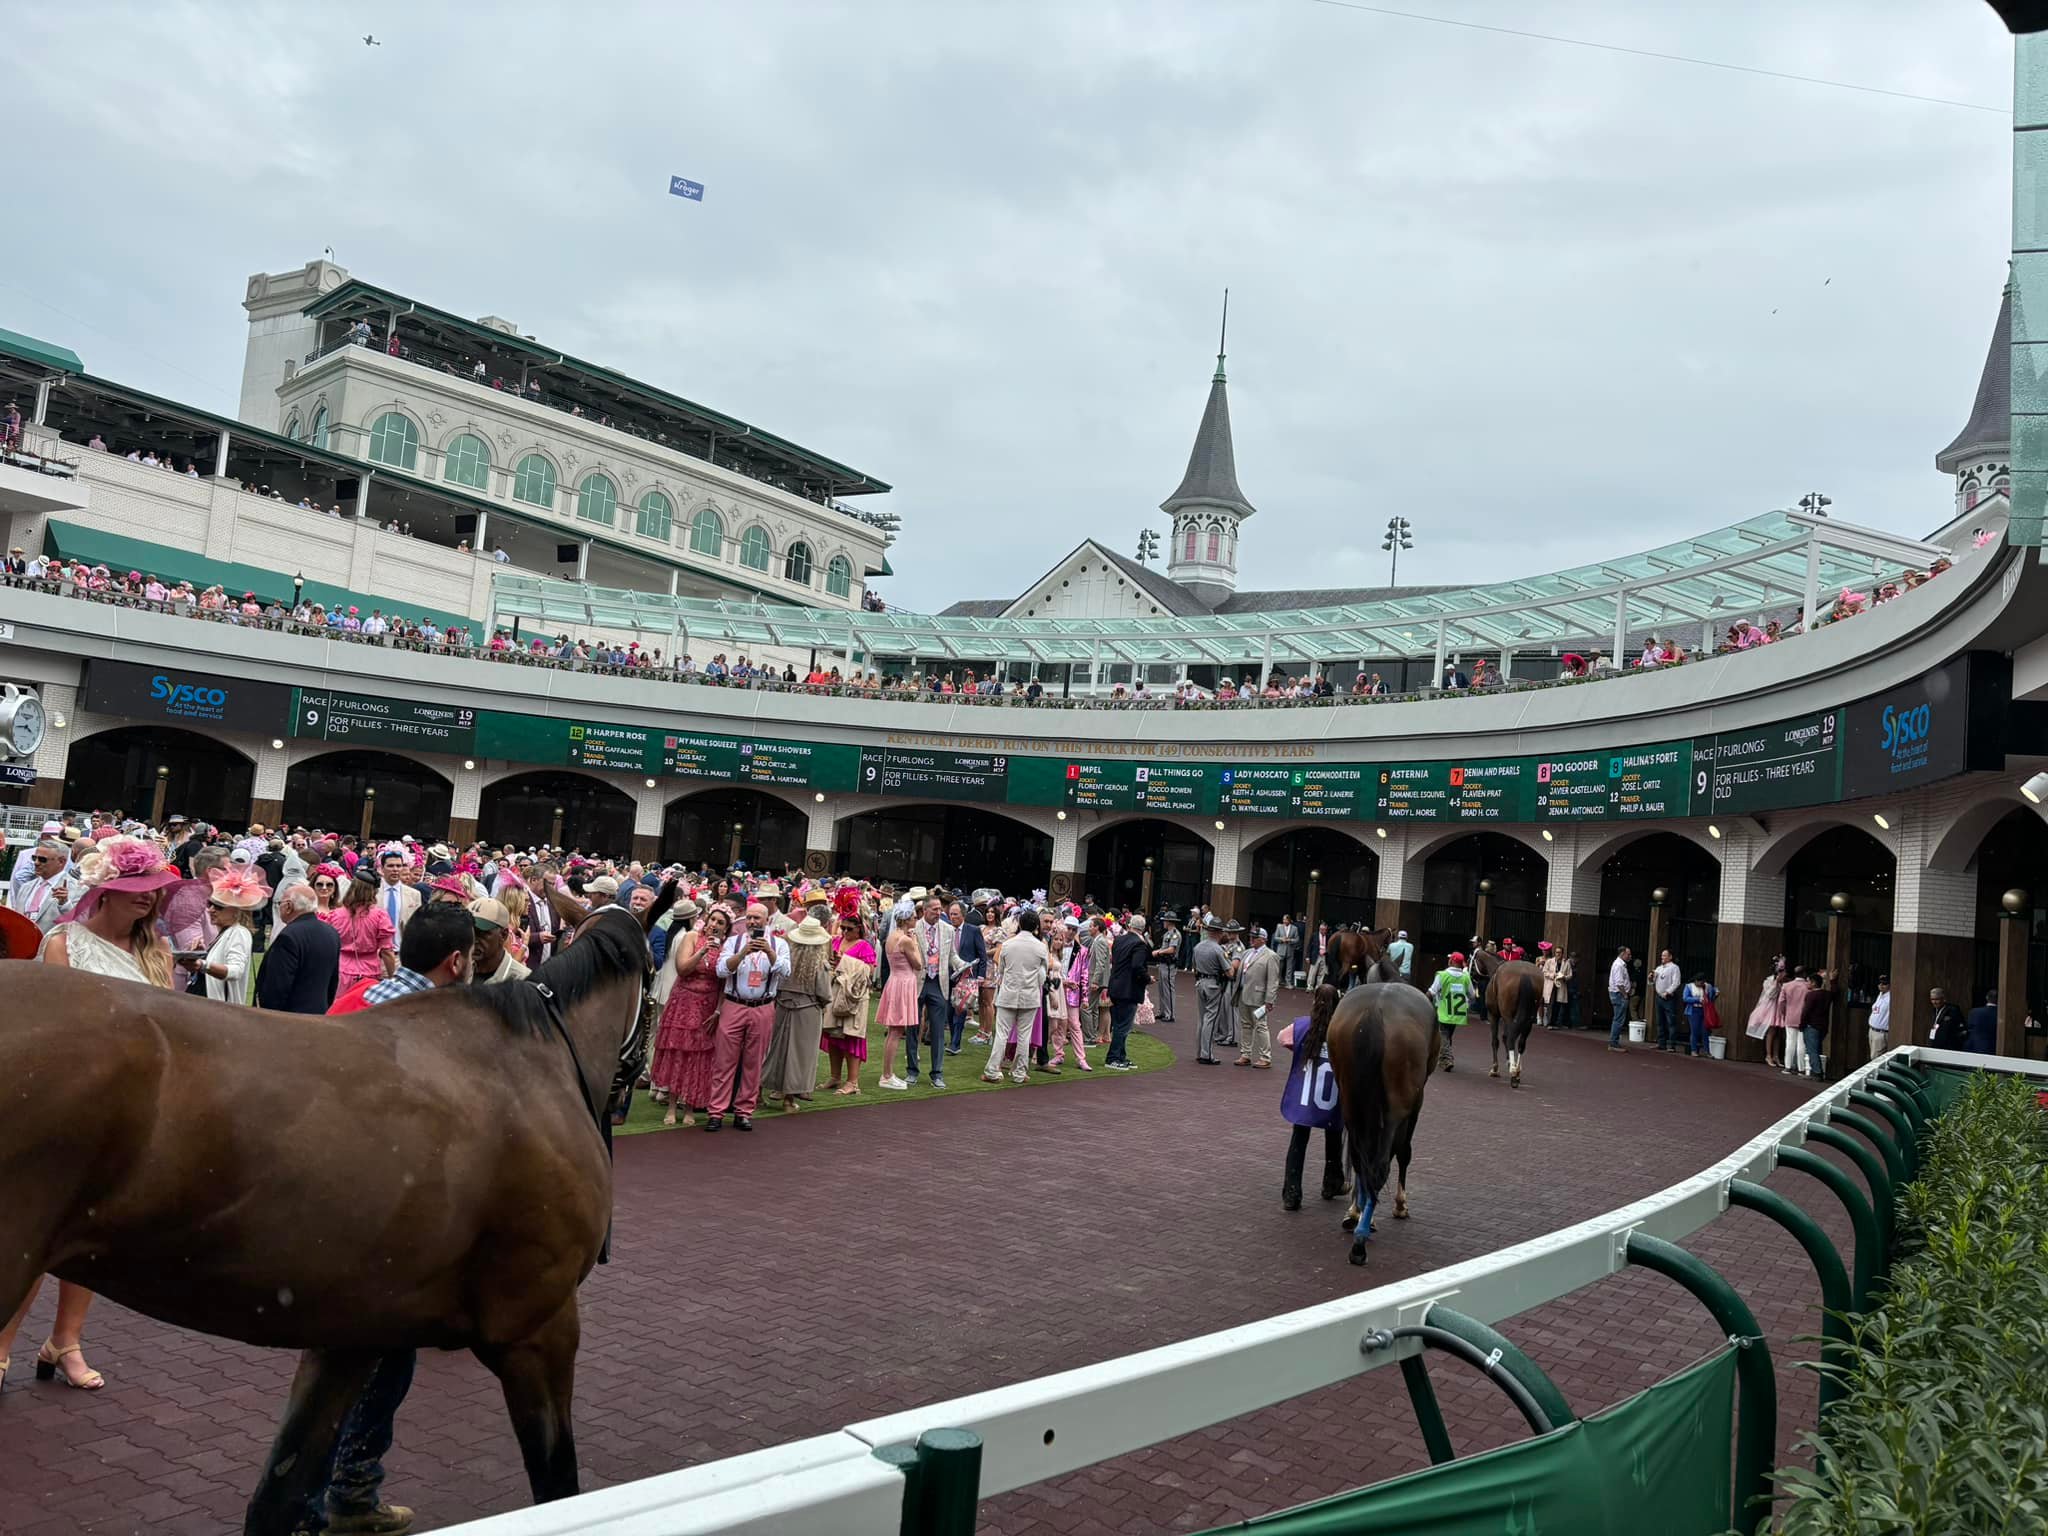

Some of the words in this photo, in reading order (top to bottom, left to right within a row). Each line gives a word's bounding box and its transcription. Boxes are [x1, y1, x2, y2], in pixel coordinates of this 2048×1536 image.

[302, 696, 327, 706] RACE
[332, 699, 338, 707] 7
[339, 700, 390, 713] FURLONGS
[307, 710, 319, 726] 9
[459, 710, 473, 720] 19
[329, 716, 349, 726] FOR
[351, 719, 382, 729] FILLIES
[391, 723, 420, 734] THREE
[421, 727, 449, 737] YEARS
[329, 724, 349, 733] OLD
[1822, 715, 1835, 734] 19
[593, 729, 625, 738] HARPER
[626, 732, 647, 741] ROSE
[742, 745, 752, 754] 10
[754, 743, 777, 753] TANYA
[887, 734, 955, 748] KENTUCKY
[959, 737, 1000, 750] DERBY
[1003, 740, 1029, 751] RUN
[1031, 742, 1049, 752] ON
[1055, 743, 1081, 753] THIS
[1087, 744, 1129, 754] TRACK
[1131, 744, 1157, 755] FOR
[1183, 744, 1270, 757] CONSECUTIVE
[1273, 744, 1314, 757] YEARS
[1717, 746, 1723, 757] 7
[1723, 739, 1766, 757] FURLONGS
[863, 754, 883, 763] RACE
[892, 755, 935, 766] FURLONGS
[1655, 751, 1678, 764] FORTE
[1694, 749, 1714, 761] RACE
[740, 764, 750, 772] 22
[992, 757, 1006, 768] 19
[1552, 763, 1564, 773] DO
[1565, 760, 1598, 772] GOODER
[866, 767, 876, 781] 9
[1080, 765, 1103, 774] IMPEL
[1139, 770, 1146, 780] 2
[1149, 768, 1162, 776] ALL
[1163, 768, 1191, 777] THINGS
[1191, 769, 1204, 777] GO
[1234, 770, 1252, 778] LADY
[1253, 770, 1289, 779] MOSCATO
[1390, 770, 1429, 779] ASTERNIA
[1464, 768, 1484, 777] DENIM
[1484, 767, 1498, 776] AND
[1541, 767, 1547, 778] 8
[1716, 773, 1732, 786] FOR
[1733, 770, 1759, 784] FILLIES
[1766, 764, 1790, 780] THREE
[1791, 760, 1815, 775] YEARS
[885, 771, 901, 780] FOR
[902, 773, 929, 781] FILLIES
[935, 775, 960, 784] THREE
[961, 776, 985, 785] YEARS
[1223, 772, 1231, 782] 3
[1295, 773, 1302, 783] 5
[1380, 773, 1387, 784] 6
[1453, 770, 1460, 783] 7
[884, 779, 901, 787] OLD
[1697, 771, 1707, 795] 9
[1570, 784, 1606, 794] CASTELLANO
[1715, 786, 1732, 799] OLD
[1221, 794, 1230, 803] 16
[1537, 796, 1547, 806] 20
[1610, 792, 1619, 803] 12
[1445, 991, 1467, 1016] 12
[1300, 1058, 1339, 1111] 10
